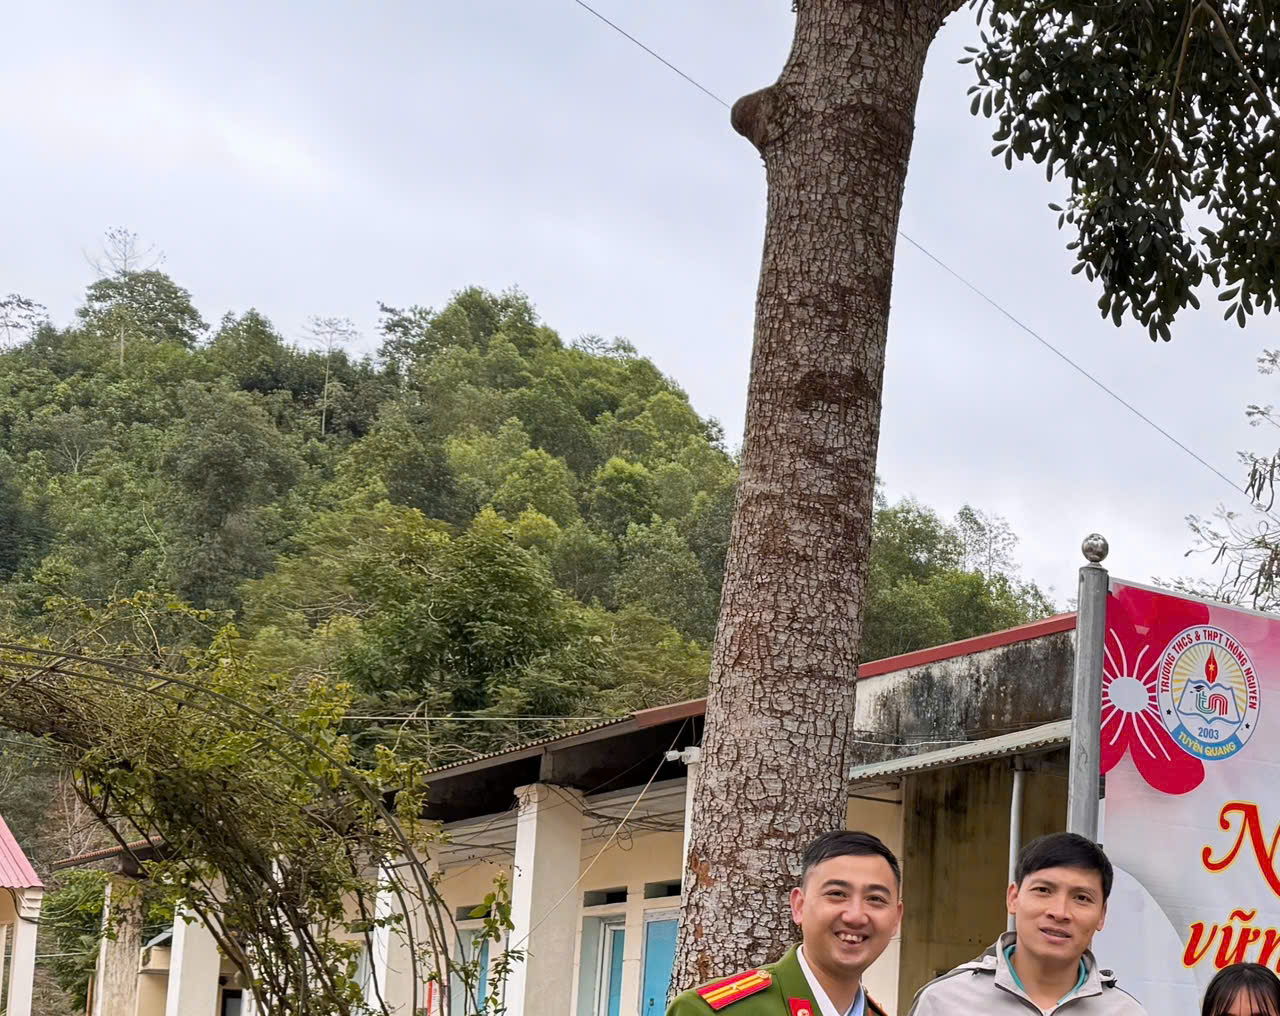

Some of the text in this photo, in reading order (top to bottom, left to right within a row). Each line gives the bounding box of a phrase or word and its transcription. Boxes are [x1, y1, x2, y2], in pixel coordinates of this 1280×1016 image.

[1172, 633, 1193, 655] THCS
[1194, 630, 1201, 640] &
[1203, 629, 1224, 644] THPT
[1198, 727, 1219, 740] 2003
[1204, 742, 1236, 757] QUANG
